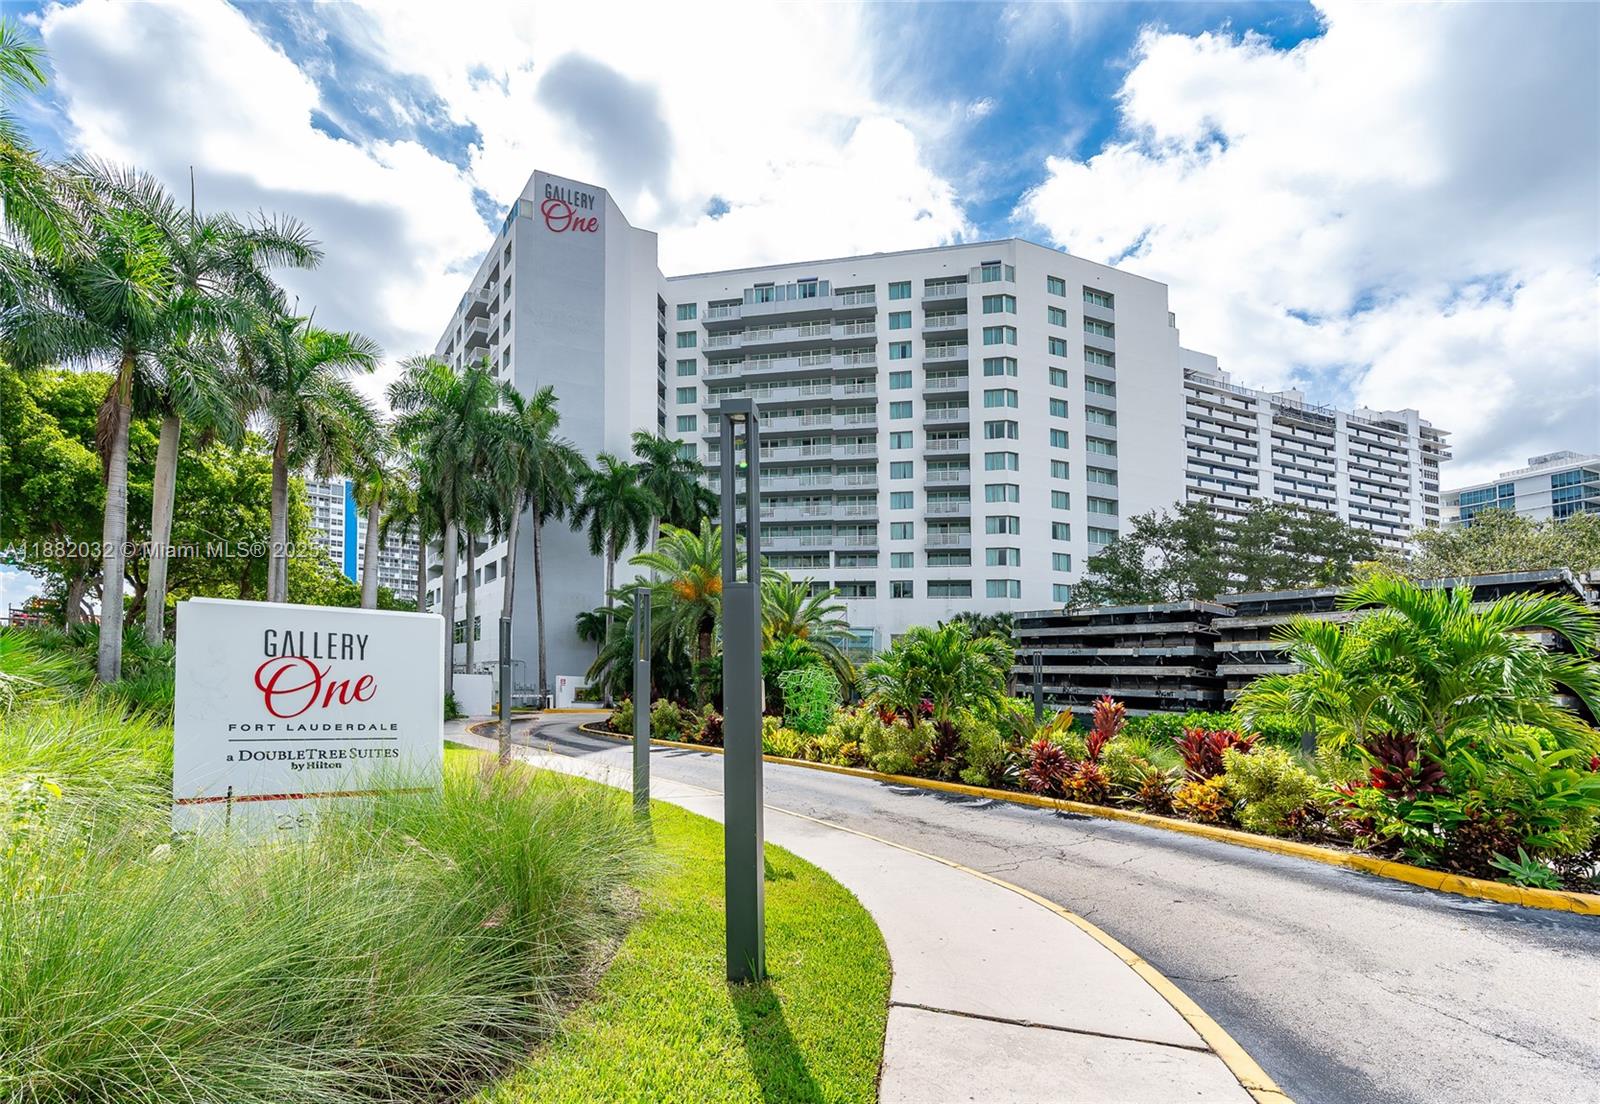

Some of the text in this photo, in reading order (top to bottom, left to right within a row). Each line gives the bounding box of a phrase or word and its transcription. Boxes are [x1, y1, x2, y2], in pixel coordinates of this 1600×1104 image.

[544, 183, 595, 210] GALLERY
[541, 198, 599, 232] One
[264, 629, 369, 661] GALLERY
[254, 656, 378, 719] One
[228, 723, 398, 732] FORT LAUDERDALE
[226, 754, 234, 762] a
[290, 761, 342, 771] by Hilton
